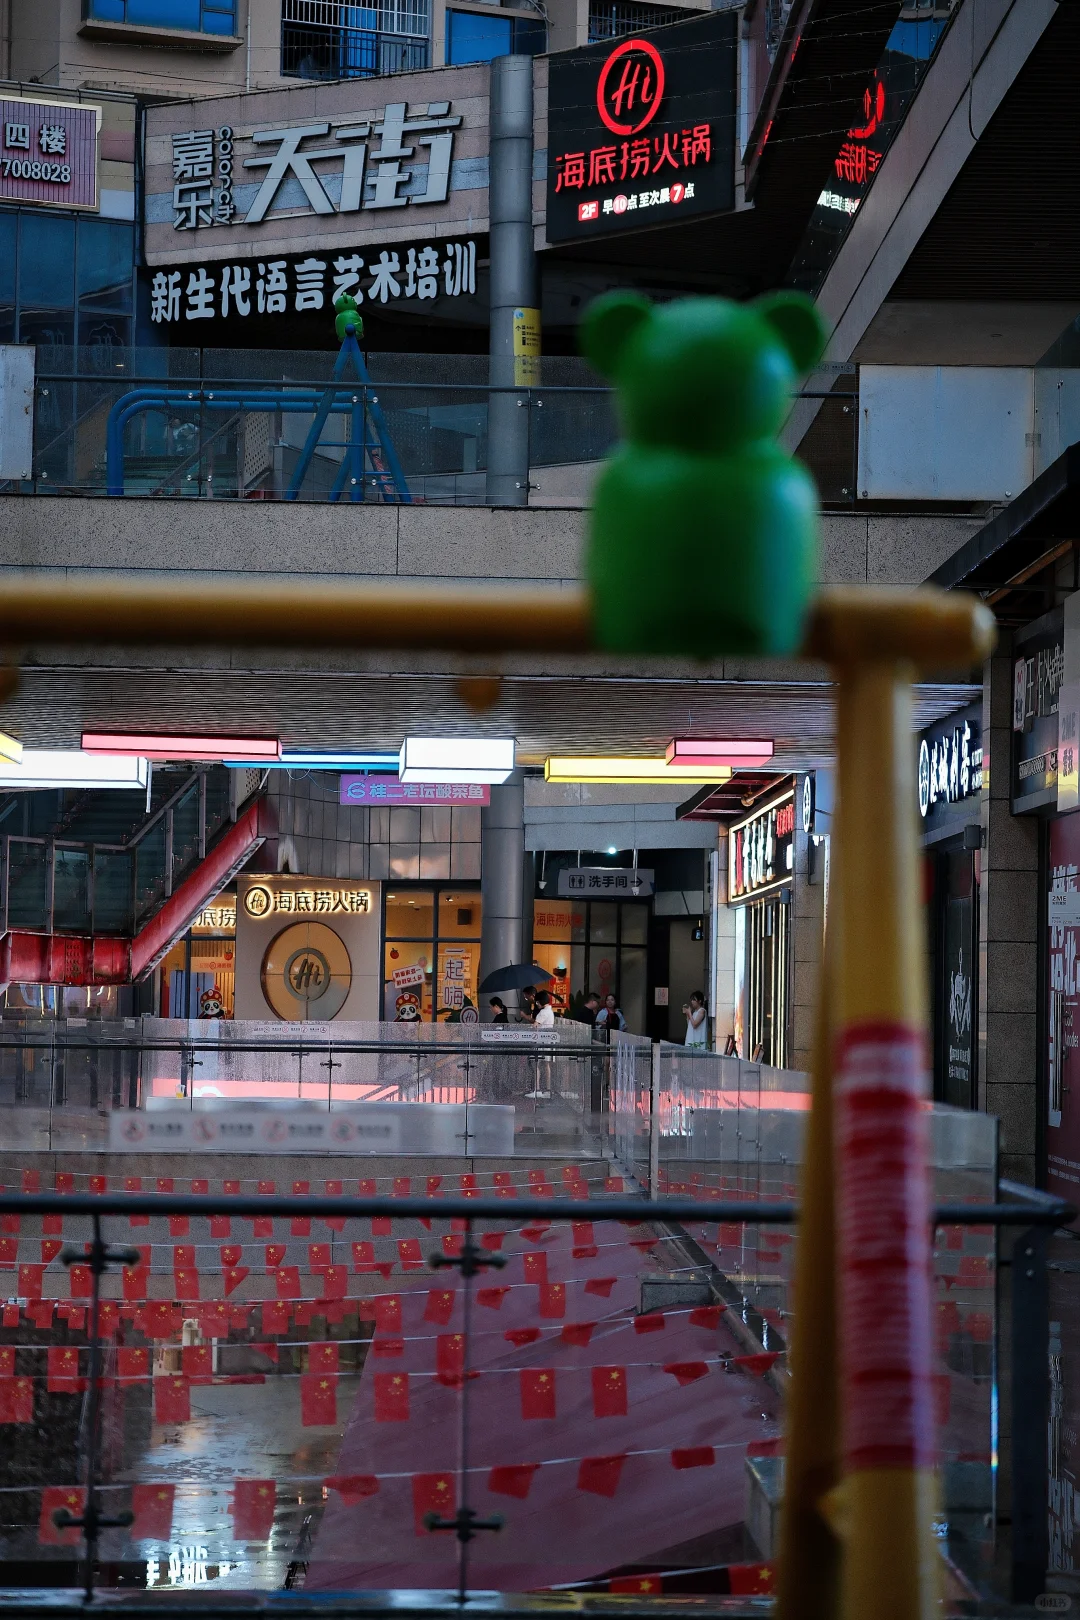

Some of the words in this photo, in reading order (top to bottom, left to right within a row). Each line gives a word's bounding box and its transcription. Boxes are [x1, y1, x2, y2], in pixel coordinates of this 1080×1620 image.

[6, 122, 66, 155] 四楼
[0, 158, 71, 183] 7008028
[243, 100, 463, 224] 天街
[555, 124, 711, 193] 海底捞火锅
[172, 129, 214, 230] 嘉乐
[581, 203, 597, 219] 2F
[151, 241, 477, 323] 新生代语言艺术培训
[369, 783, 485, 799] 桂二老坛酸菜鱼
[588, 875, 628, 889] 洗手间
[273, 890, 369, 912] 海底捞火锅
[192, 908, 236, 927] 底捞
[444, 949, 465, 1008] 一起嗨
